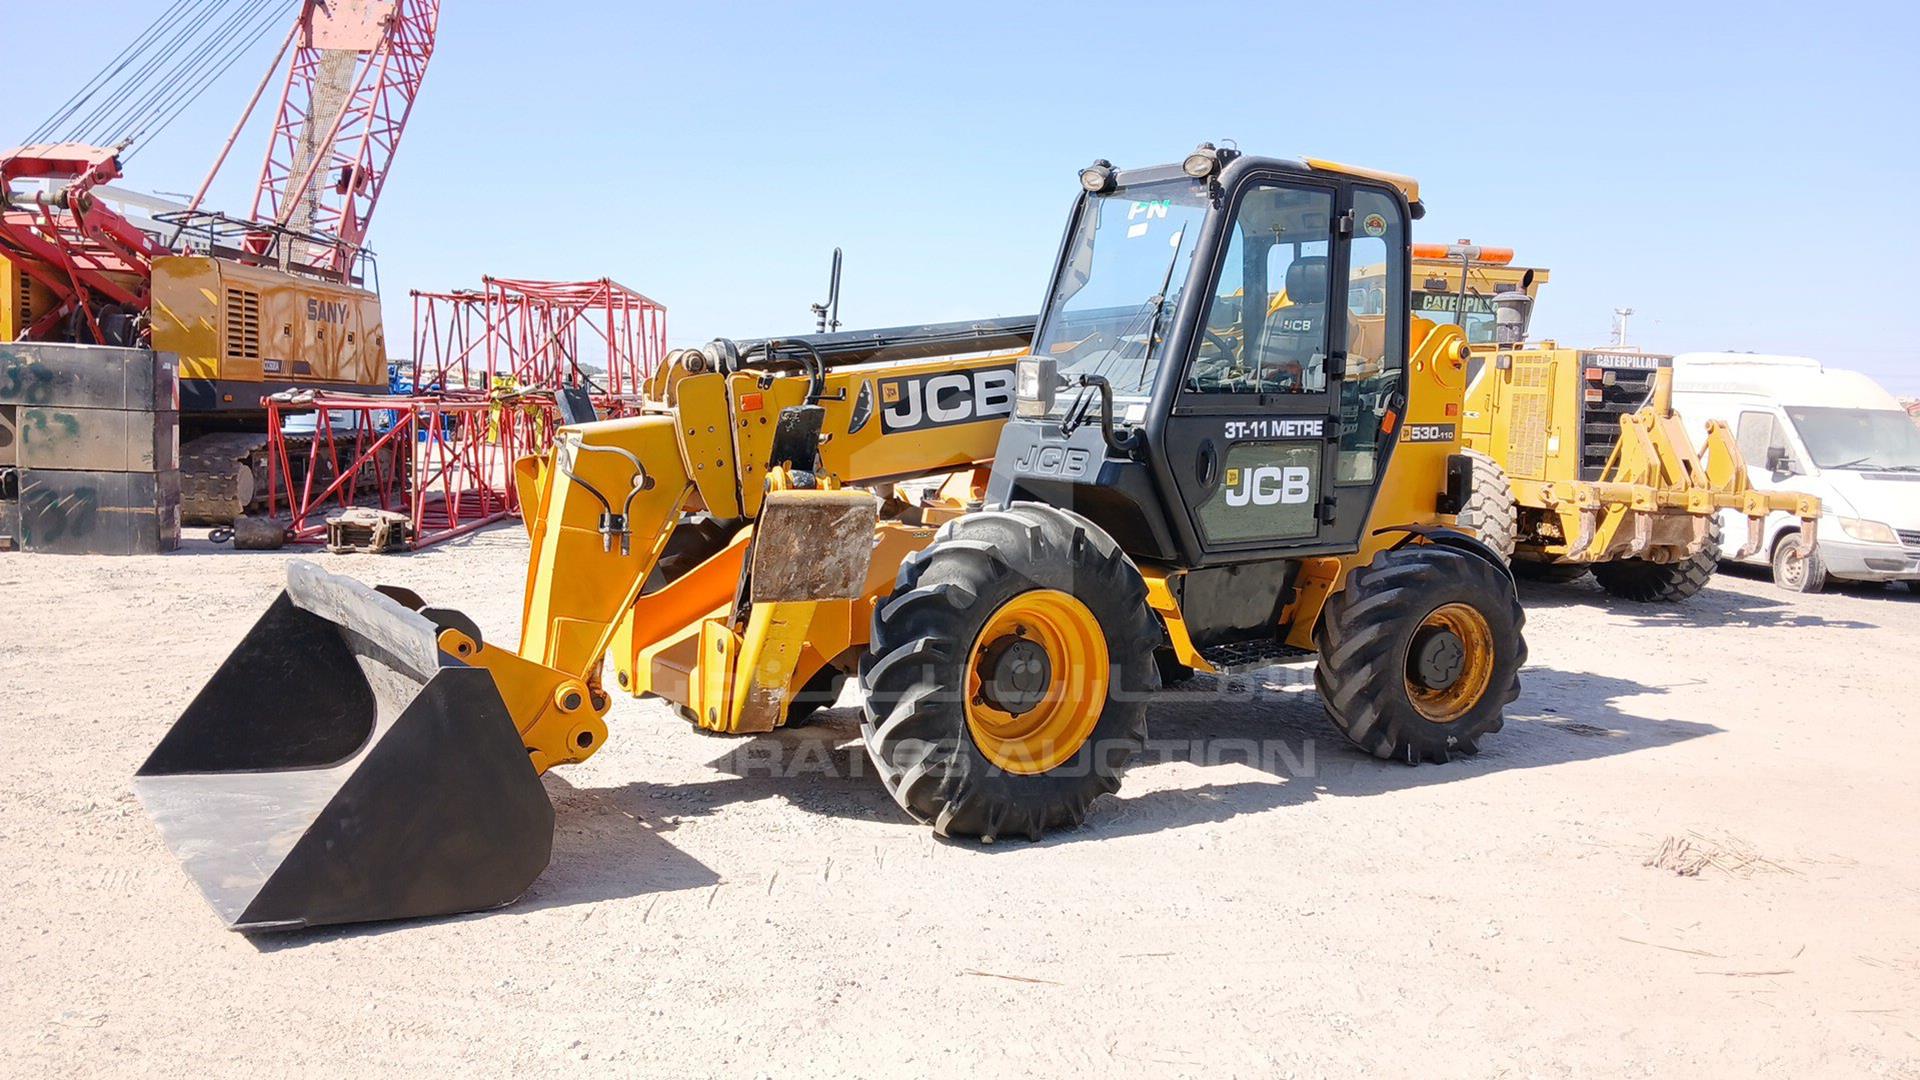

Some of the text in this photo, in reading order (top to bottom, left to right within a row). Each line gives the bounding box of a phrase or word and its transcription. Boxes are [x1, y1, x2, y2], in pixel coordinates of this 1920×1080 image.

[307, 298, 347, 325] SANY
[1423, 295, 1499, 314] CATEPILLA
[1283, 320, 1312, 331] JCB
[1597, 354, 1660, 370] CATERPILLAR
[884, 368, 1018, 429] JCB
[1225, 420, 1324, 439] 3T-11 METRE
[1014, 444, 1091, 477] JCB
[1225, 466, 1310, 507] JCB
